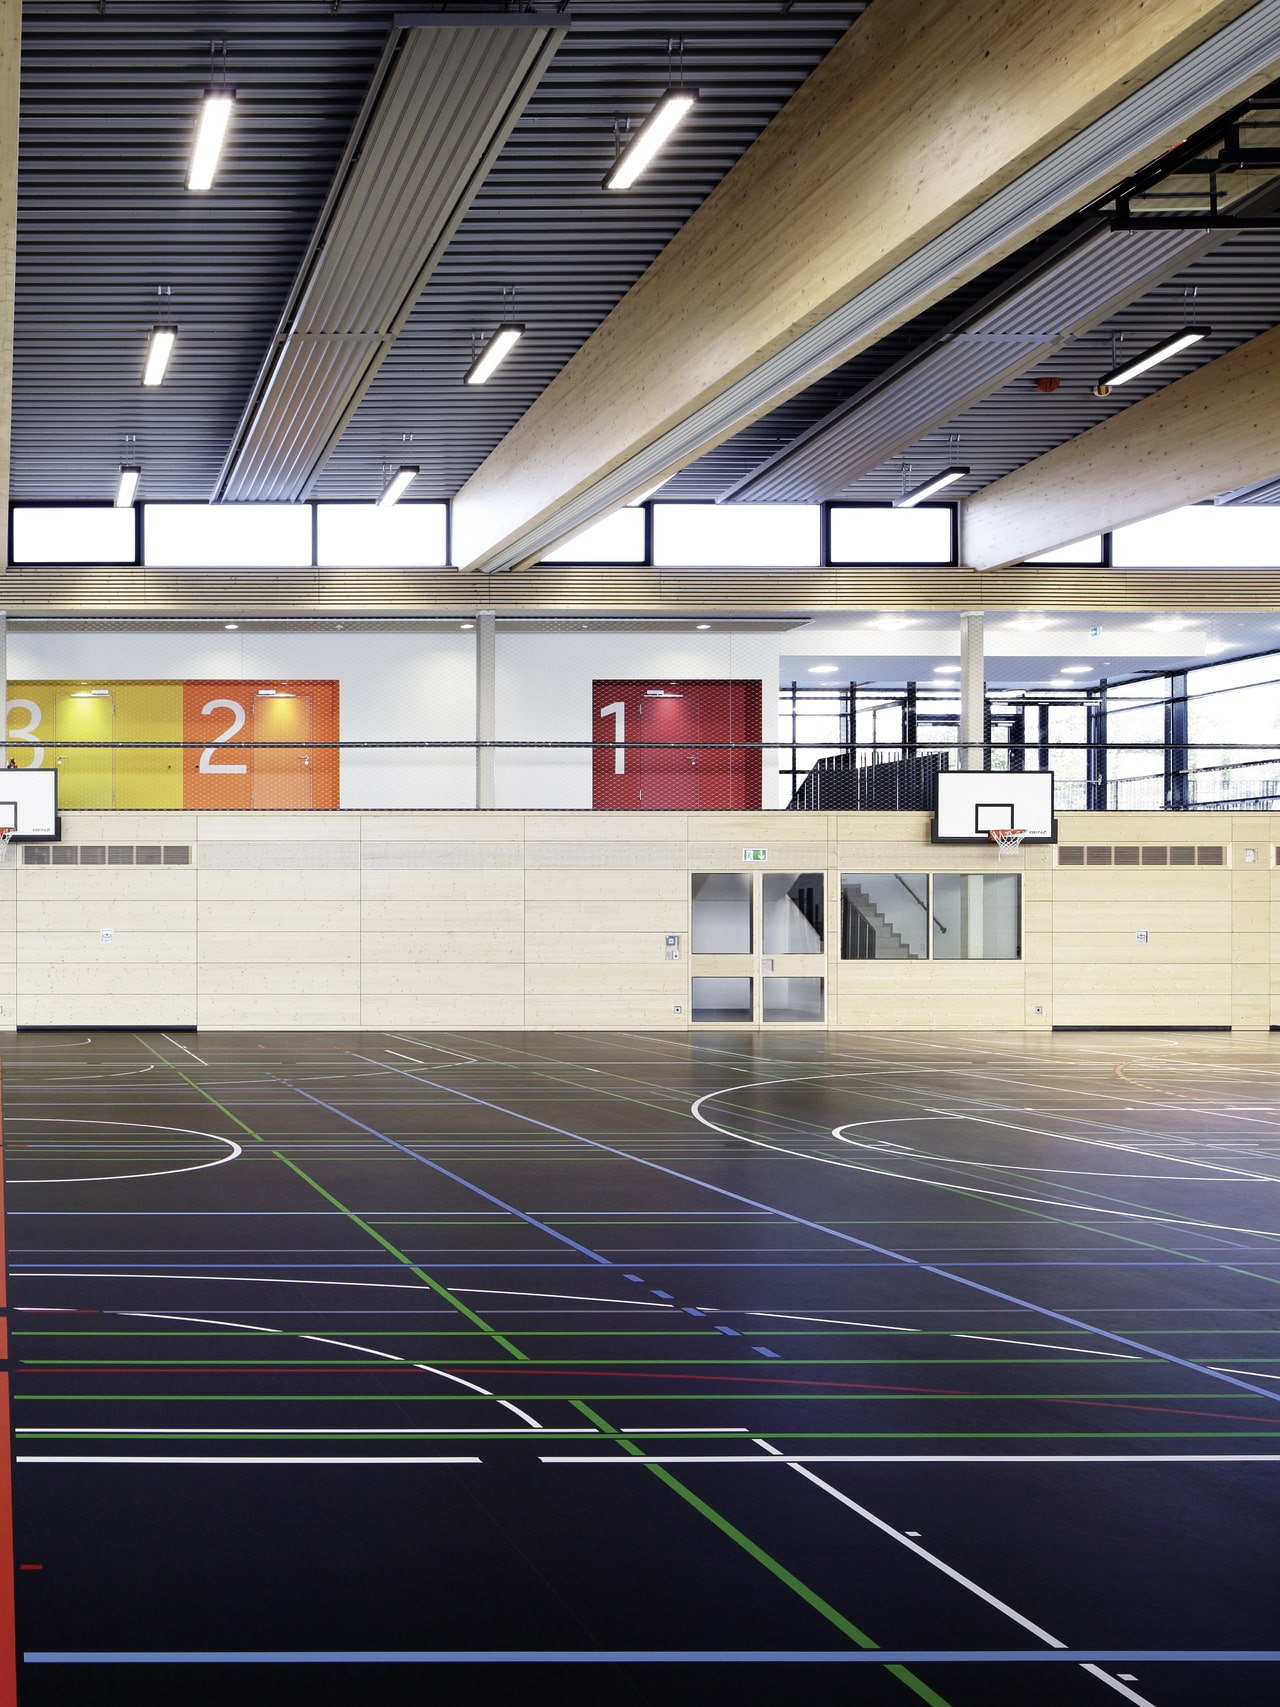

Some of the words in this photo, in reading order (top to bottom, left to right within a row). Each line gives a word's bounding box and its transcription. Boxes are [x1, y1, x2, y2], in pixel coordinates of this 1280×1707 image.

[6, 699, 45, 768] 3
[199, 699, 247, 774] 2
[600, 701, 625, 775] 1
